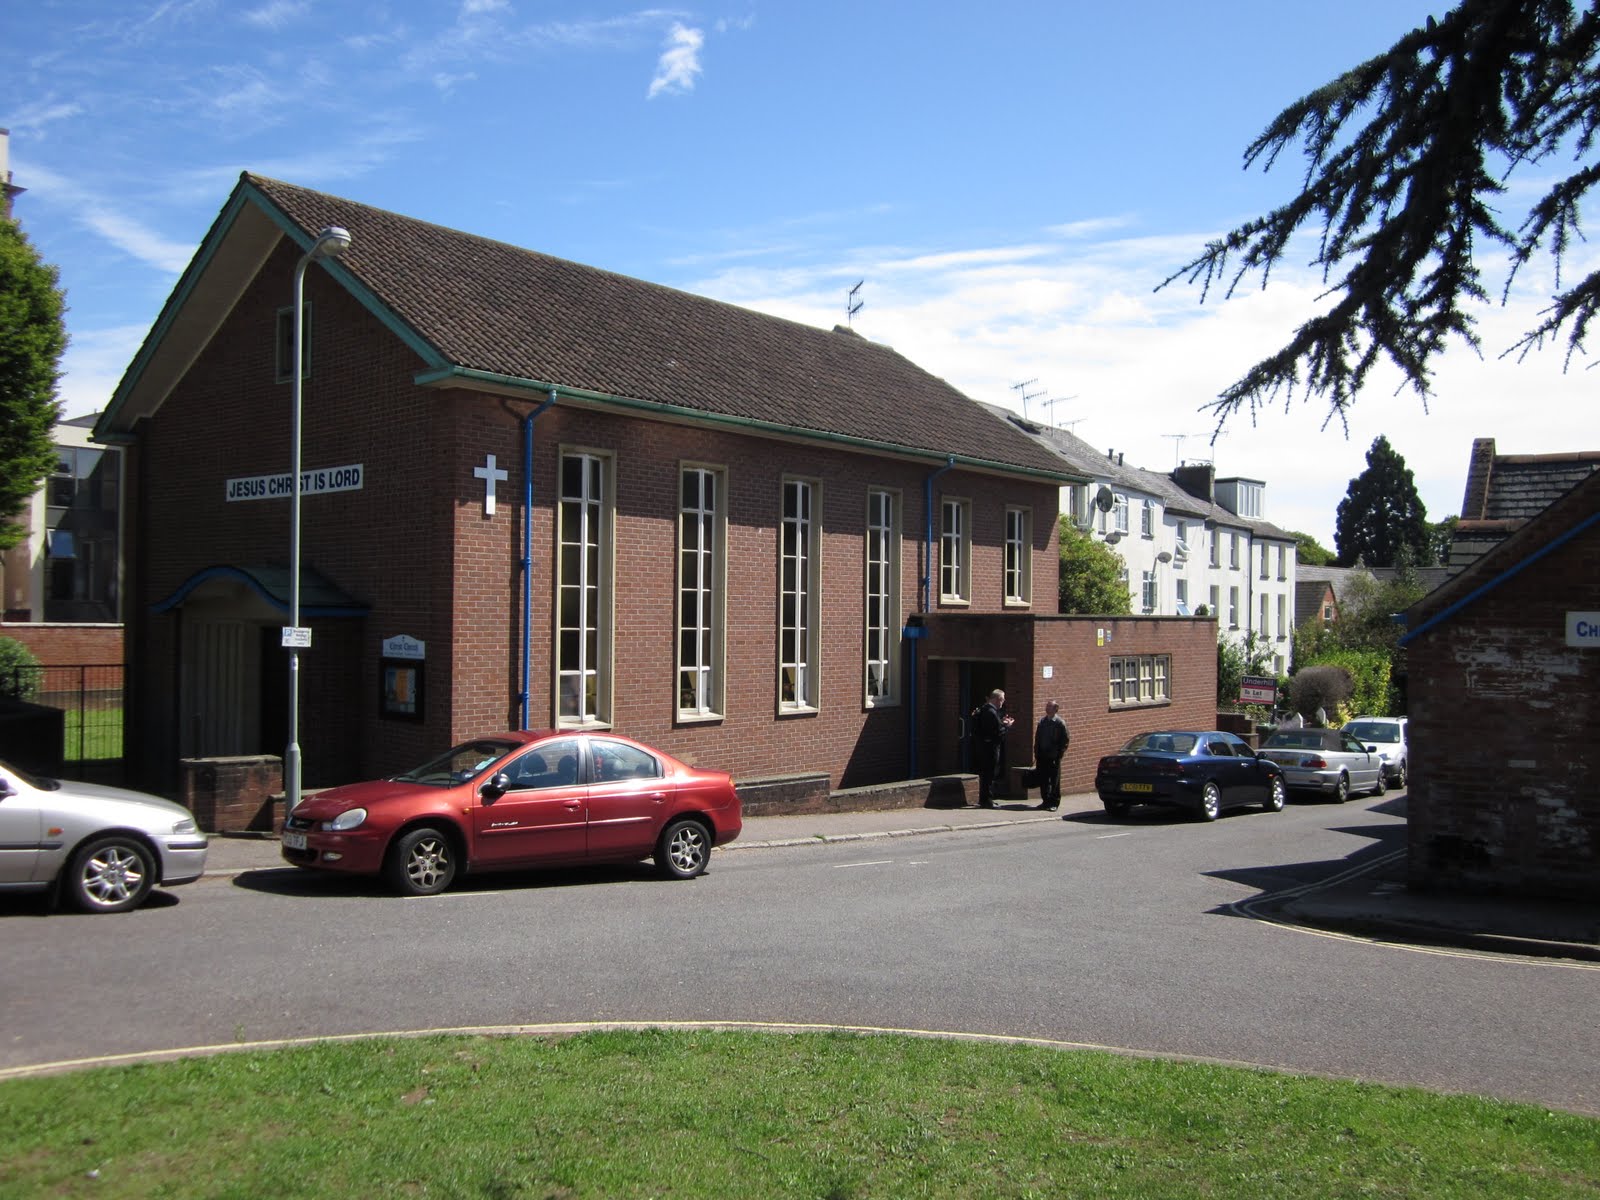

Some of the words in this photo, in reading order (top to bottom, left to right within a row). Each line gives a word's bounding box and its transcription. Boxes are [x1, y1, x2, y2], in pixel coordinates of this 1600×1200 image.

[229, 479, 266, 498] JESUS
[268, 474, 311, 494] CHRST
[314, 472, 325, 490] IS
[329, 468, 360, 488] LORD
[1243, 677, 1274, 686] Underhill
